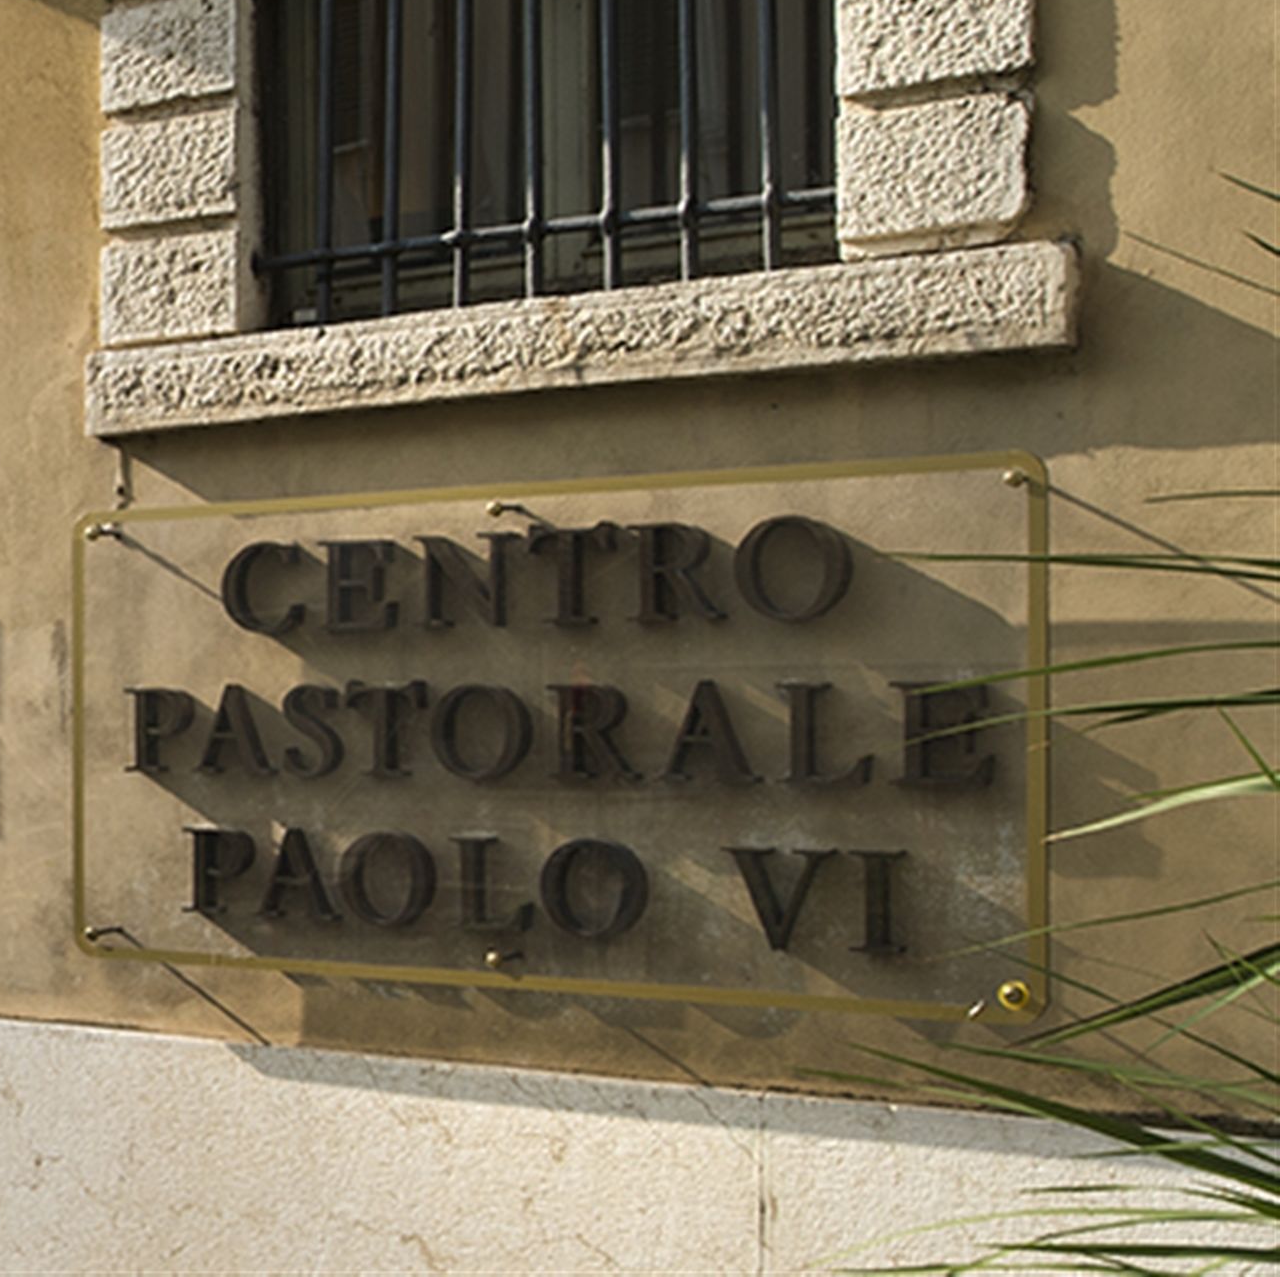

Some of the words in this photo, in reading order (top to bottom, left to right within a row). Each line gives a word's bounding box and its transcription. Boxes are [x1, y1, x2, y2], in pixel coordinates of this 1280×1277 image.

[220, 514, 854, 635] CENTRO
[123, 678, 997, 789] PASTORALE
[182, 825, 649, 938] PAOLO
[722, 846, 907, 954] VI
